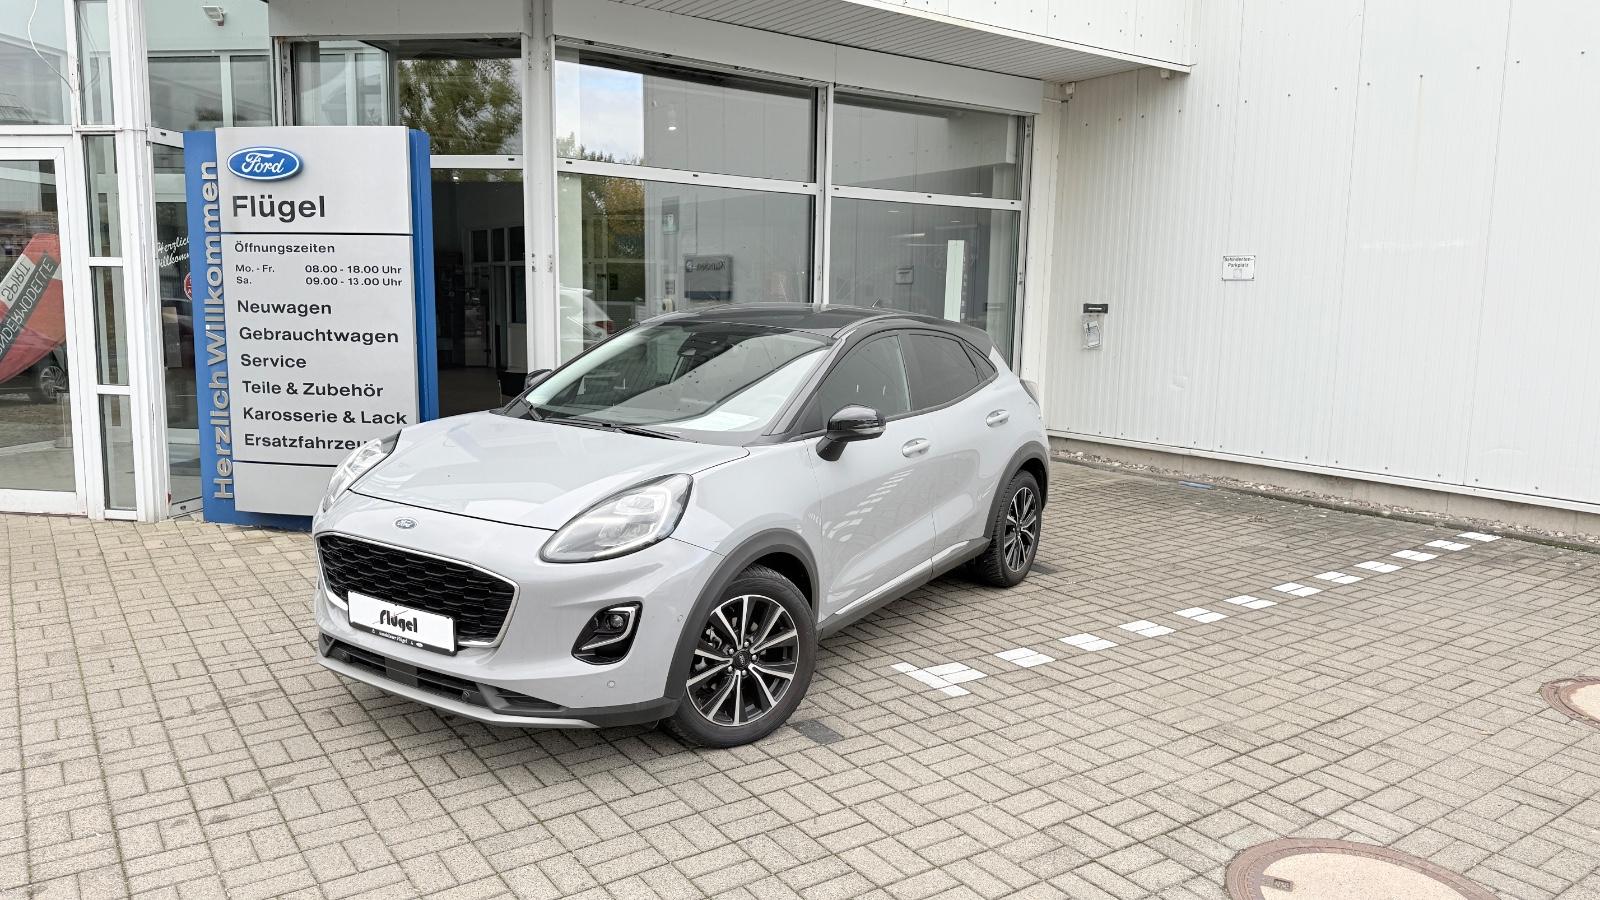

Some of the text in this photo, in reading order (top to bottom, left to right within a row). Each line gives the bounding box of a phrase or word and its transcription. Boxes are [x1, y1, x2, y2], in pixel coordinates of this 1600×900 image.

[241, 152, 285, 174] Ford
[232, 194, 326, 223] Flügel
[234, 240, 336, 255] Öffnungszeiten
[235, 264, 254, 273] Mo.
[262, 264, 275, 273] Fr.
[304, 265, 338, 274] 08.00
[347, 265, 379, 274] 18.00
[381, 265, 402, 274] Uhr
[236, 276, 252, 285] Sa.
[305, 277, 338, 286] 09.00
[348, 277, 380, 286] 13.00
[382, 278, 403, 287] Uhr
[237, 300, 332, 317] Neuwagen
[201, 161, 234, 499] Herzlich Willkommen
[239, 327, 399, 345] Gebrauchtwagen
[240, 353, 307, 368] Service
[242, 380, 384, 397] Teile & Zubehör
[243, 407, 407, 425] Karosserie & Lack
